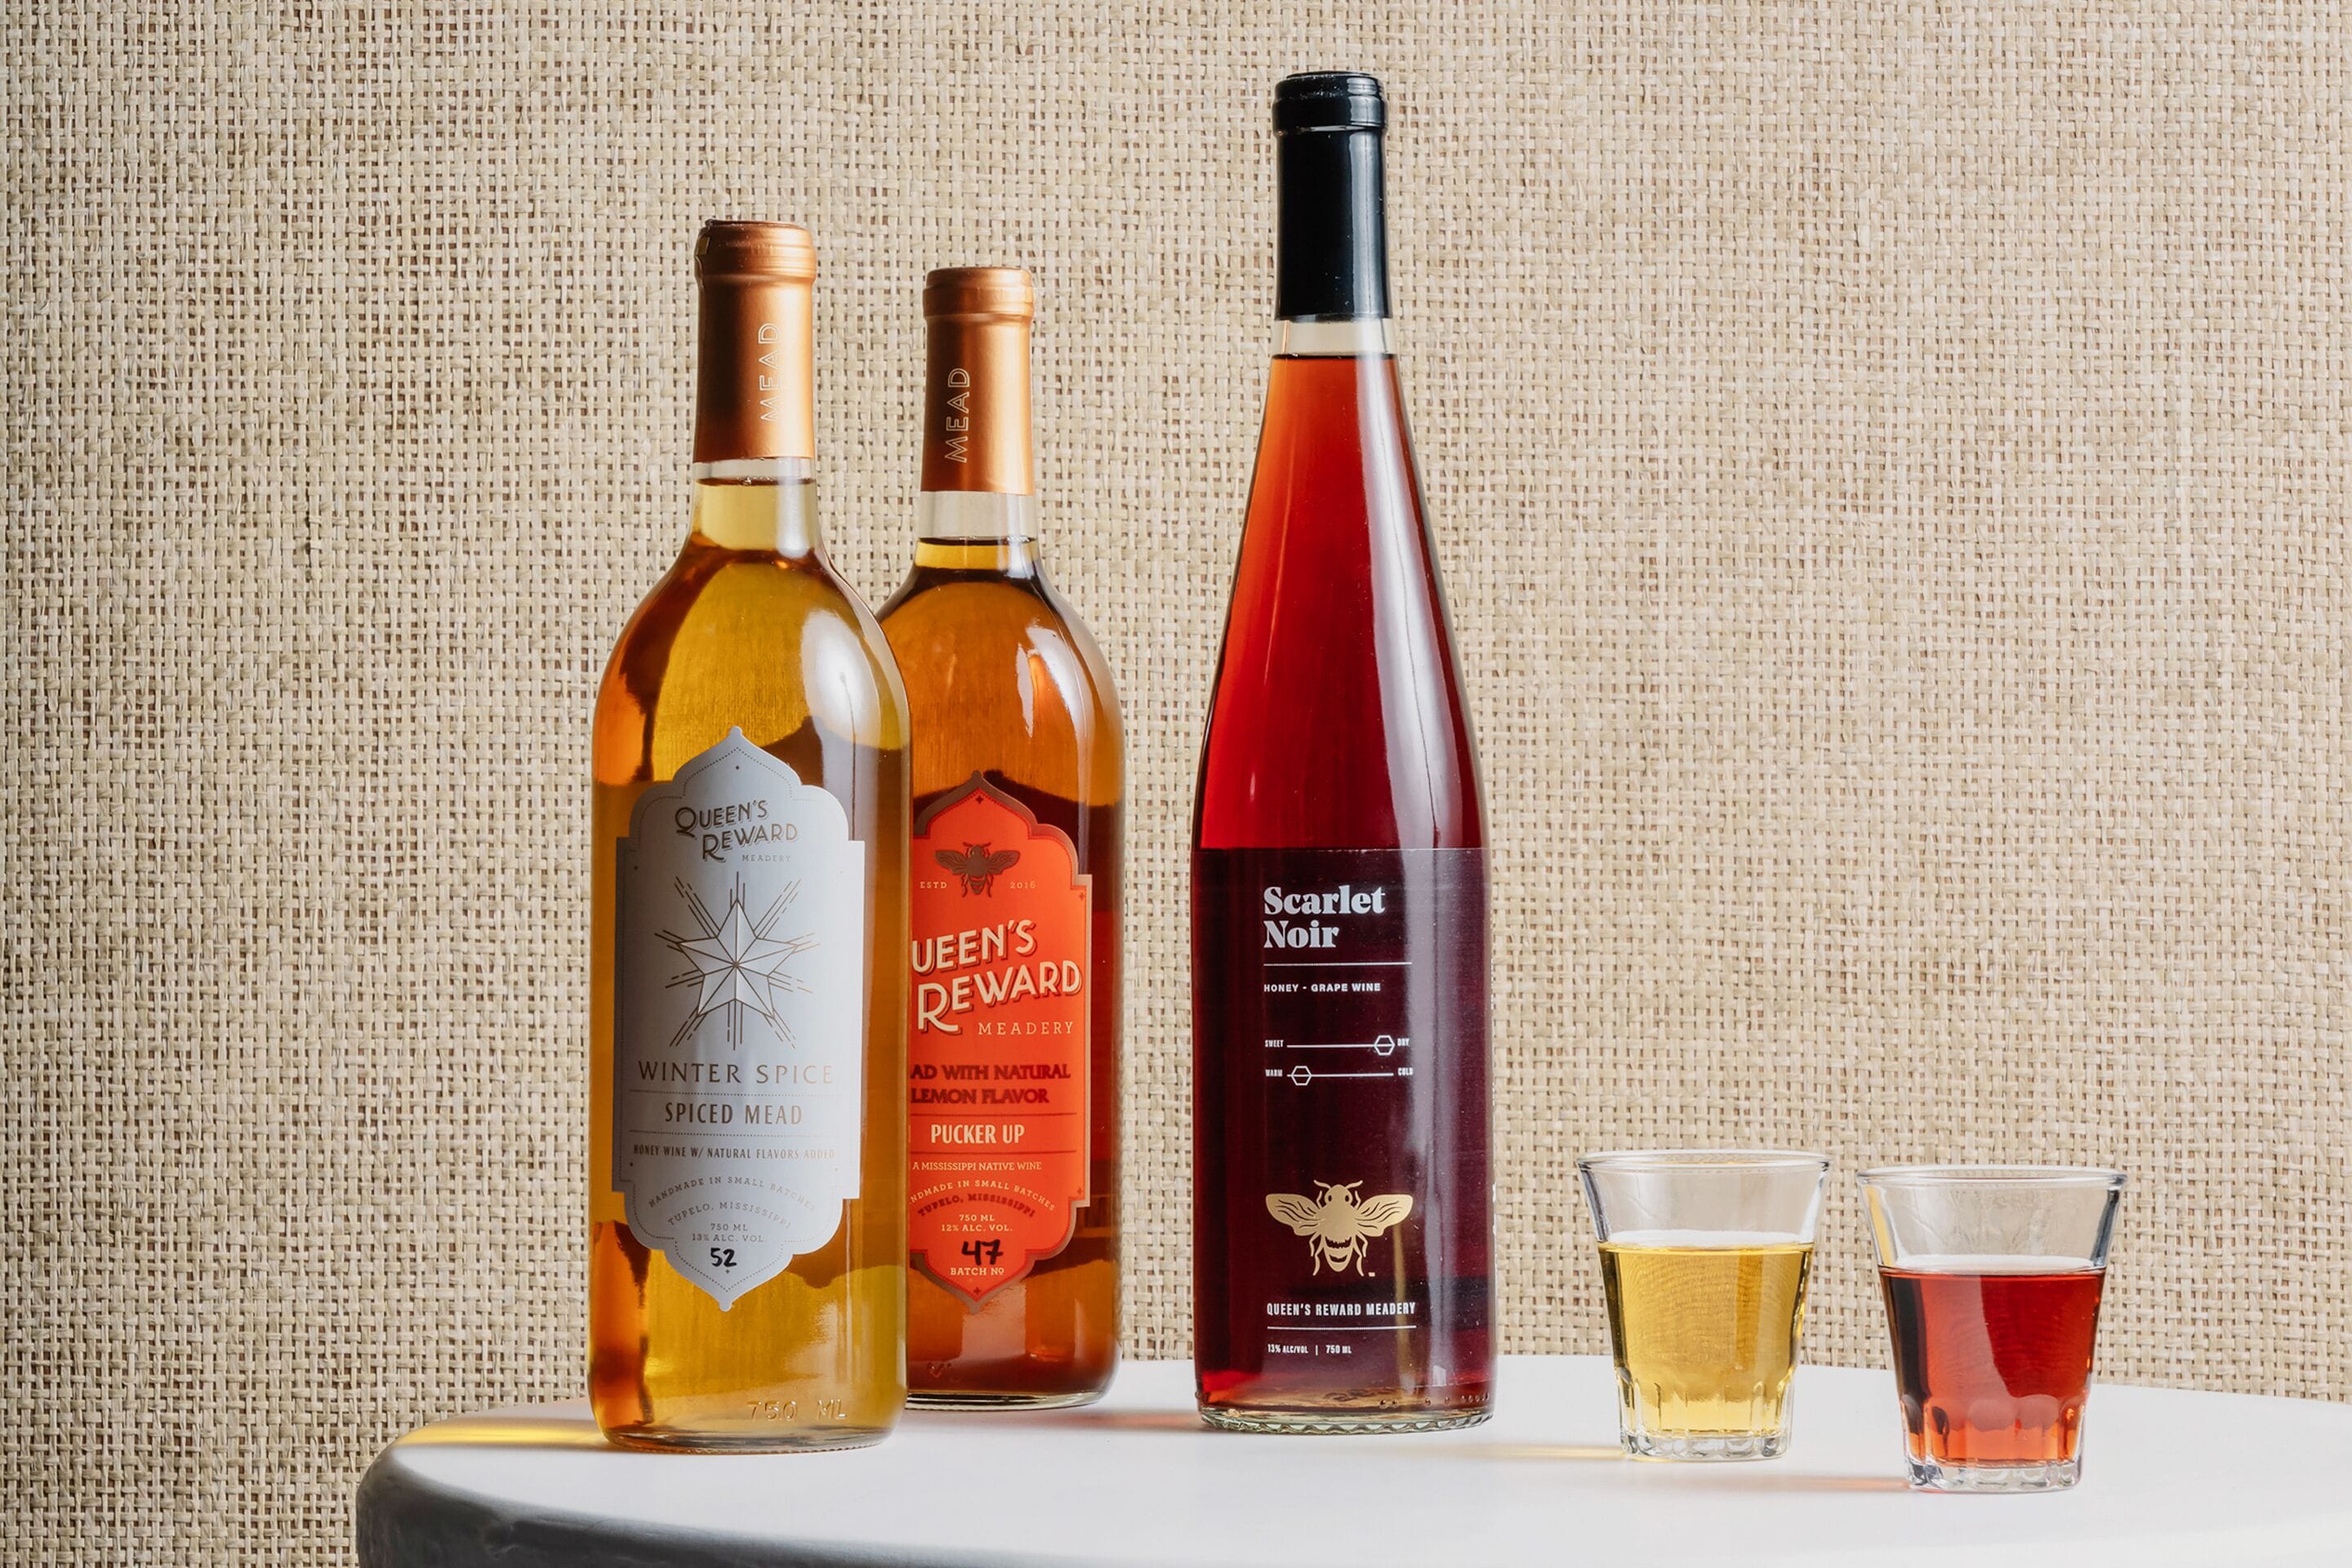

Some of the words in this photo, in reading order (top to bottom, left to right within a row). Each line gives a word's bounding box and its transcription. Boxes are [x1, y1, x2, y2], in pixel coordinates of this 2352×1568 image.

[758, 323, 782, 423] MEAD
[944, 368, 971, 463] MEAD
[675, 800, 769, 840] QUEEN'S
[702, 822, 799, 863] REWARD
[742, 854, 791, 862] MEADERY
[920, 881, 947, 889] ESTD
[1009, 880, 1036, 889] 2016
[1263, 884, 1386, 915] Scarlet
[1263, 919, 1339, 949] Noir
[911, 919, 1038, 977] UEEN'S
[1263, 983, 1298, 992] HONEY
[1311, 983, 1348, 992] GRAPE
[1352, 982, 1381, 992] WINE
[917, 960, 1083, 1036] REWARD
[978, 1021, 1074, 1036] MEADERY
[1264, 1039, 1284, 1048] SWEET
[1396, 1037, 1410, 1047] DRY
[638, 1060, 742, 1084] WINTER
[755, 1064, 835, 1085] SPICE
[910, 1064, 938, 1080] AD
[941, 1064, 989, 1080] WITH
[994, 1063, 1071, 1080] NATURAL
[1397, 1067, 1414, 1076] COLD
[910, 1088, 978, 1104] LEMON
[982, 1088, 1050, 1104] FLAVOR
[665, 1102, 733, 1124] SPICED
[745, 1104, 802, 1125] MEAD
[930, 1124, 997, 1144] PUCKER
[1002, 1124, 1026, 1144] UP
[634, 1143, 660, 1156] HONEY
[663, 1145, 686, 1157] WINE
[691, 1147, 703, 1159] W/
[707, 1147, 751, 1159] NATURAL
[756, 1148, 799, 1160] FLAVORS
[804, 1149, 835, 1160] ADDED
[912, 1161, 920, 1170] A
[921, 1161, 977, 1171] MISSISSIPPI
[978, 1161, 1015, 1171] NATIVE
[1017, 1161, 1042, 1170] WINE
[648, 1177, 705, 1209] HANDMADE
[709, 1176, 722, 1184] IN
[727, 1176, 764, 1188] SMALL
[910, 1182, 954, 1204] NDMADE
[957, 1180, 970, 1188] IN
[974, 1179, 1010, 1191] SMALL
[1013, 1184, 1056, 1212] BATCHES
[916, 1193, 964, 1218] TUPELO,
[967, 1192, 1036, 1218] MISSISSIPPI
[666, 1202, 715, 1227] TUPELO,
[719, 1201, 791, 1230] MISSISSIPPI
[959, 1214, 978, 1222] 750
[980, 1214, 995, 1222] ML
[710, 1223, 729, 1232] 750
[733, 1223, 748, 1232] ML
[941, 1224, 959, 1232] 12%
[962, 1224, 987, 1232] ALC.
[989, 1223, 1013, 1232] VOL.
[692, 1233, 709, 1242] 13%
[710, 1247, 737, 1267] 52
[960, 1238, 1004, 1265] 47
[950, 1267, 987, 1276] BATCH
[1267, 1303, 1311, 1316] QUEEN'S
[1316, 1303, 1361, 1316] REWARD
[1365, 1302, 1416, 1316] MEADERY
[1267, 1343, 1281, 1353] 13%
[1282, 1344, 1308, 1354] ALC/VOL
[1325, 1344, 1340, 1354] 750
[1342, 1345, 1352, 1354] ML
[746, 1400, 797, 1421] 750
[817, 1398, 848, 1420] ML
